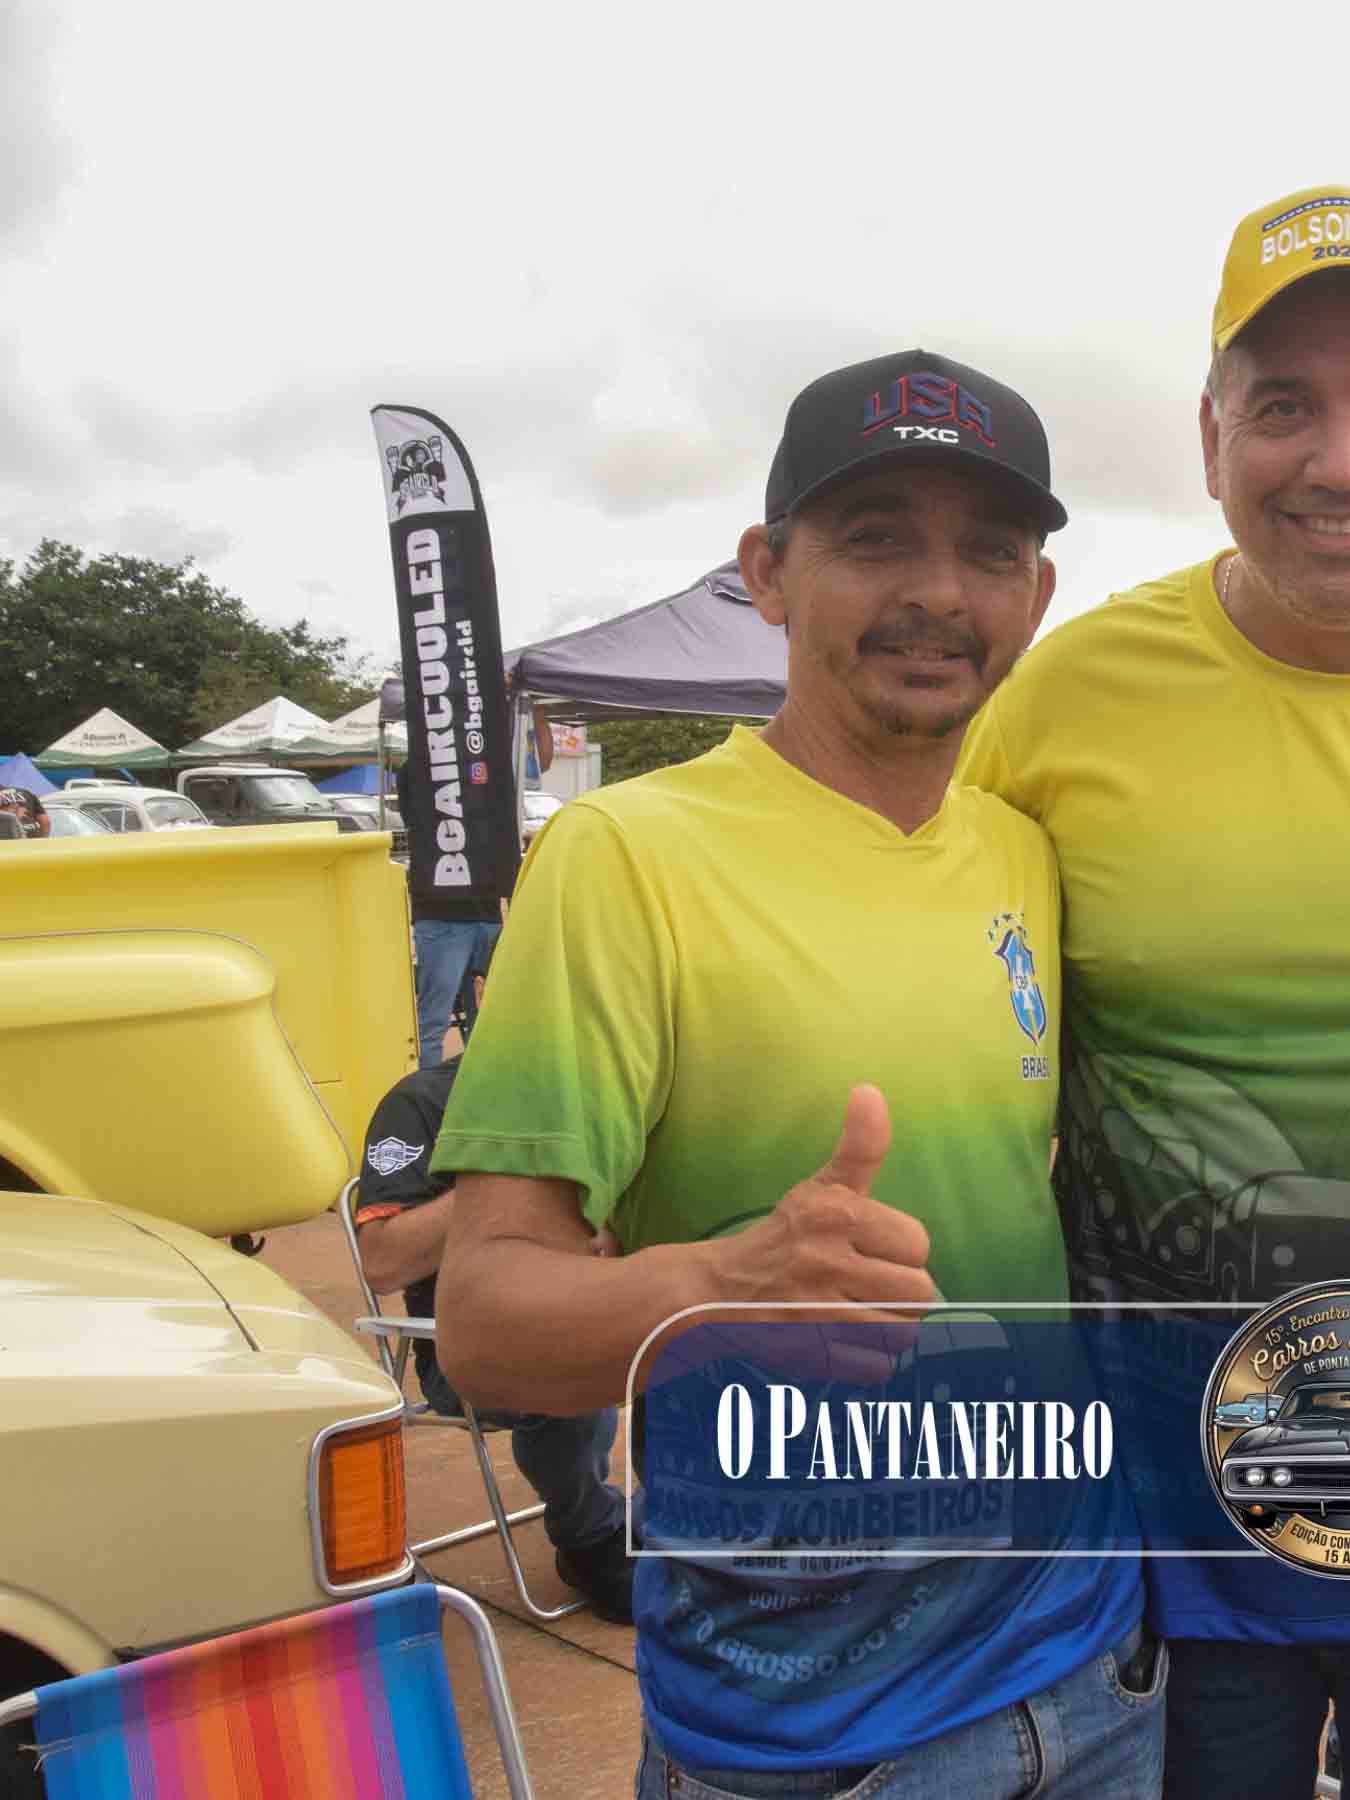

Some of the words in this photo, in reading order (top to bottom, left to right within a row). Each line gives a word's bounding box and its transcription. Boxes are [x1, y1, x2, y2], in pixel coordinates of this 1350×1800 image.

[861, 370, 998, 448] USA
[893, 426, 959, 444] TXC
[406, 528, 472, 887] BGAIRCOOLED
[456, 619, 486, 755] @bgaircld
[1023, 1057, 1051, 1079] BRAS
[716, 1636, 839, 1683] GROSSO
